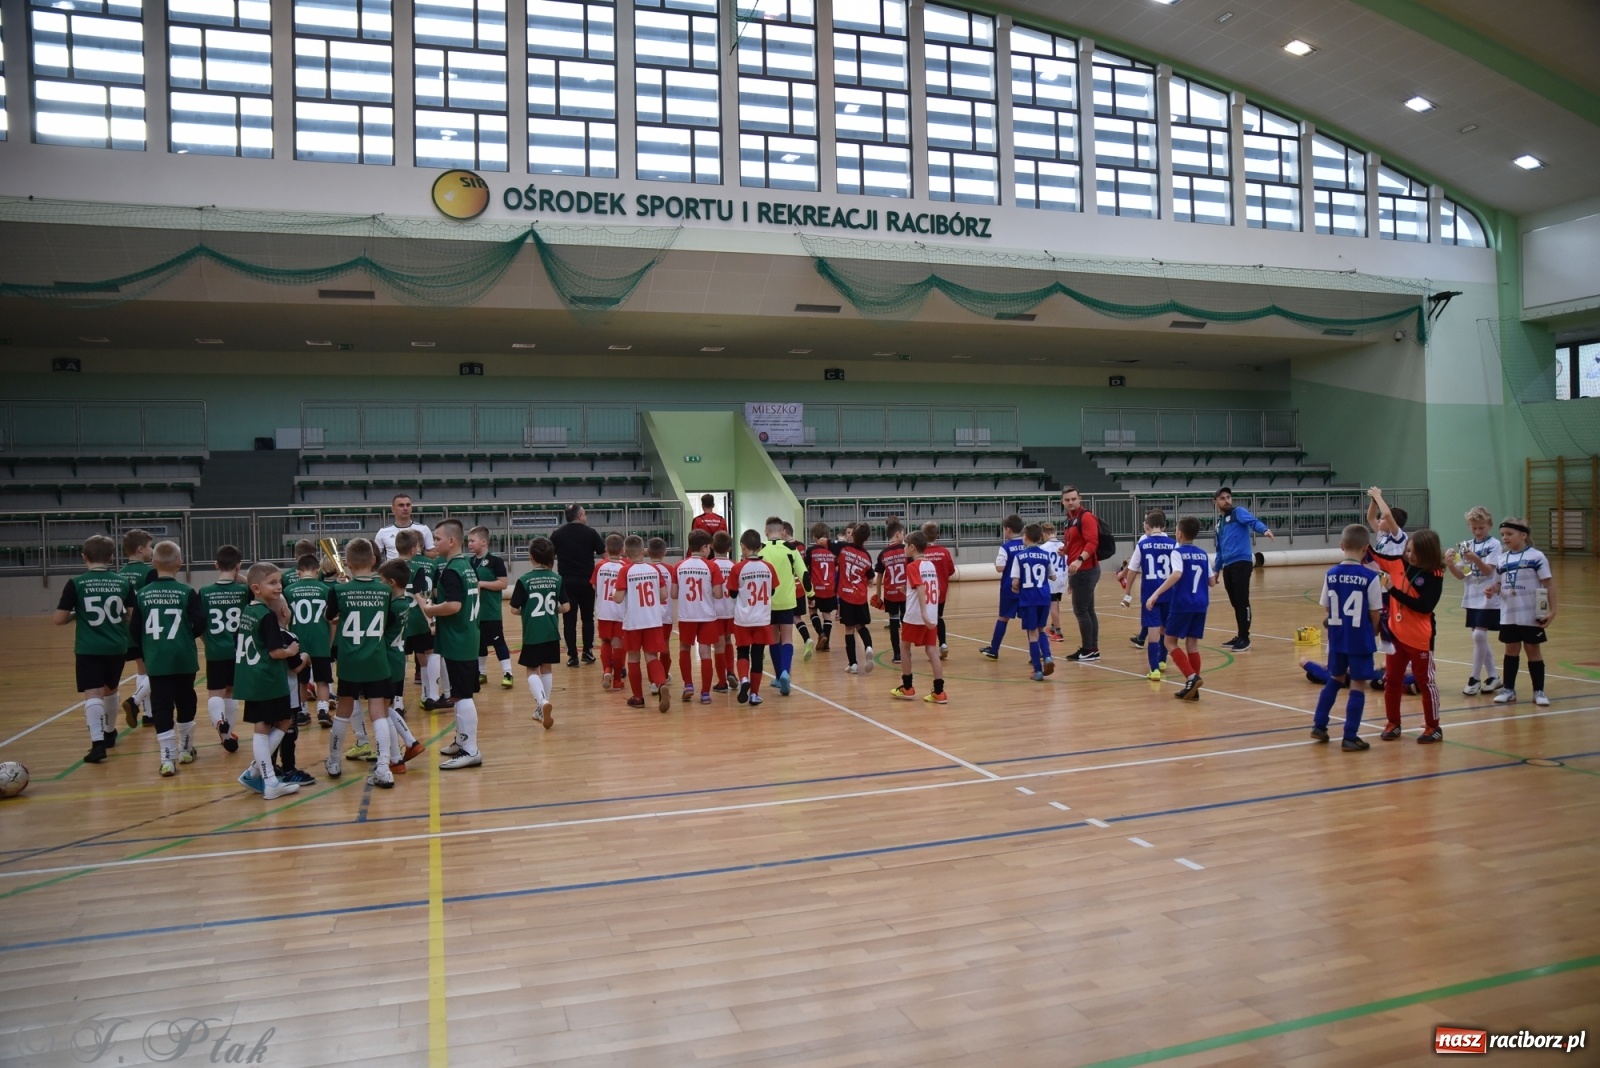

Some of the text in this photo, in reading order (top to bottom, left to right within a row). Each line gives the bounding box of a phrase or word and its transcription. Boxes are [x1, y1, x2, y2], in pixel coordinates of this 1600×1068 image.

[504, 184, 992, 238] OŚRODEK SPORTU I REKREACJI RACIBÓRZ
[752, 404, 797, 415] MIESZKO
[1153, 542, 1174, 550] CIESZYN
[820, 562, 829, 581] 7
[845, 562, 863, 585] 15
[887, 563, 907, 585] 12
[1022, 562, 1046, 588] 19
[1145, 553, 1170, 580] 13
[1191, 564, 1203, 594] 7
[685, 577, 703, 602] 31
[1339, 574, 1368, 586] CIESZYN
[143, 598, 181, 606] TWORKÓW
[346, 598, 385, 607] TWORKÓW
[529, 591, 556, 618] 26
[635, 581, 656, 607] 16
[747, 581, 769, 607] 34
[84, 595, 123, 627] 50
[209, 607, 241, 635] 38
[1327, 589, 1363, 628] 14
[145, 608, 183, 640] 47
[342, 610, 385, 645] 44
